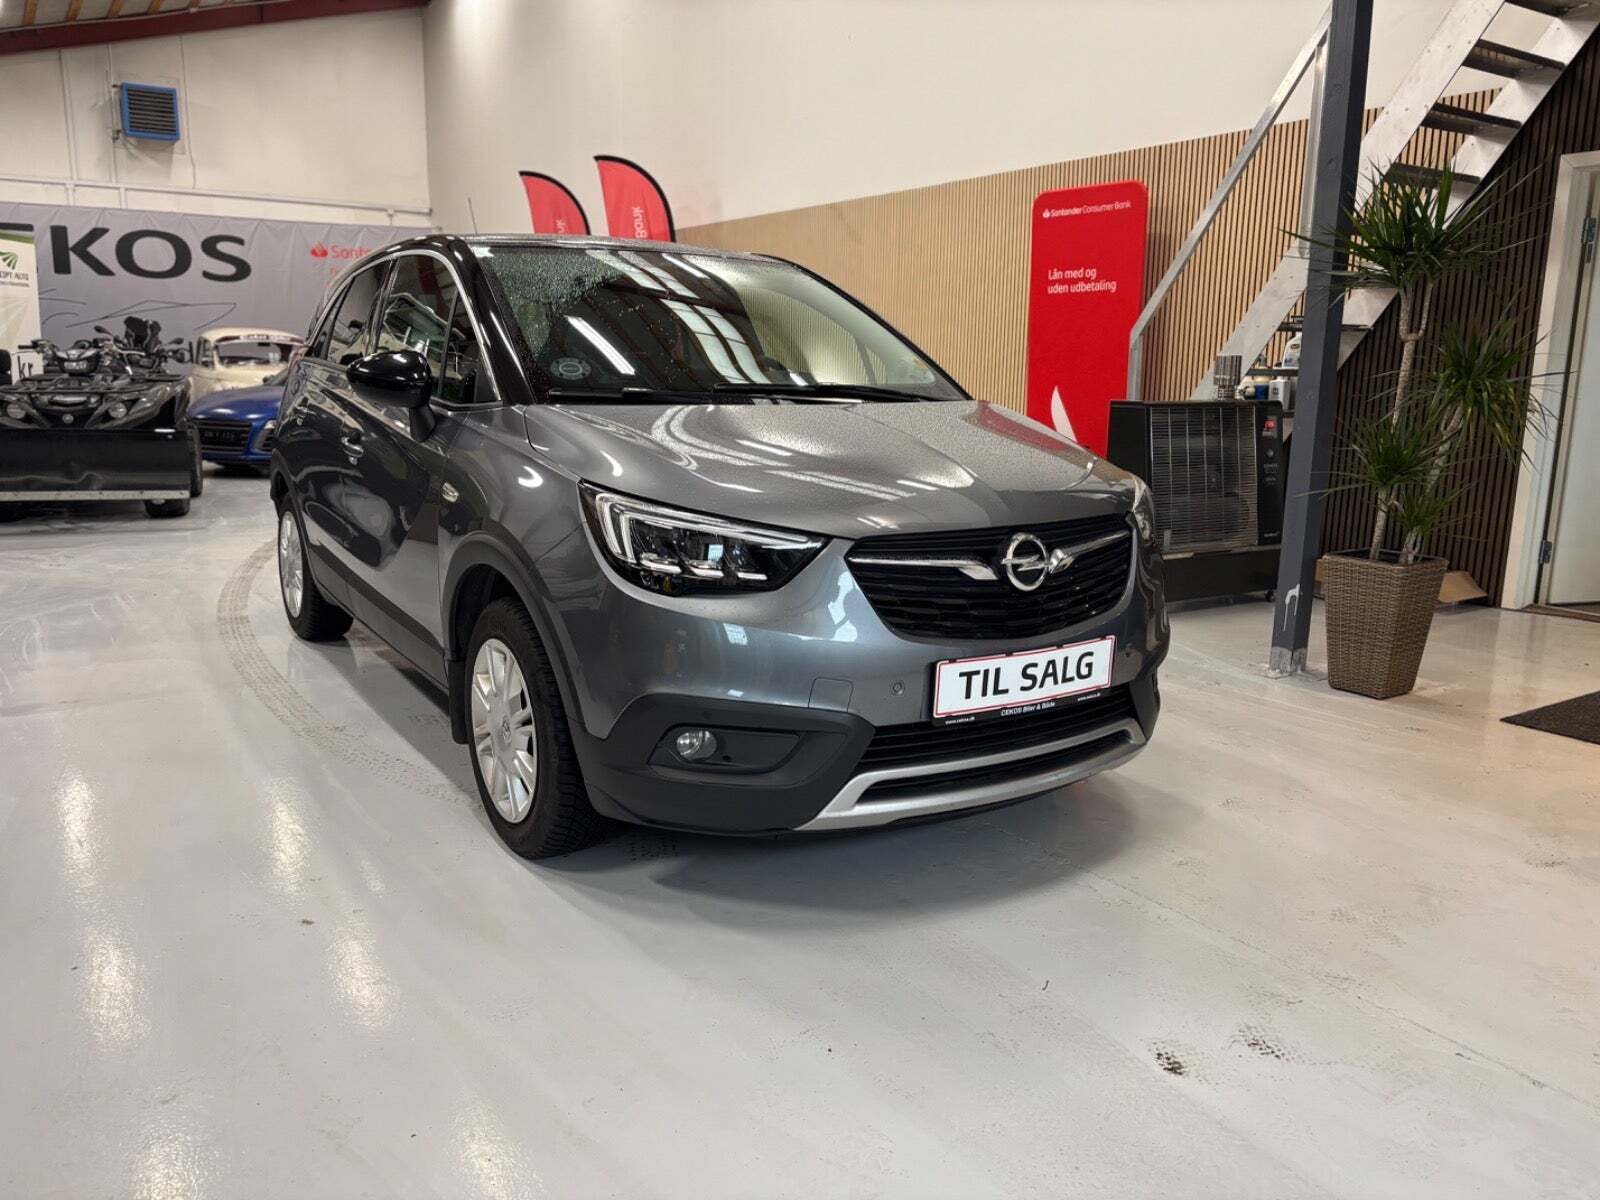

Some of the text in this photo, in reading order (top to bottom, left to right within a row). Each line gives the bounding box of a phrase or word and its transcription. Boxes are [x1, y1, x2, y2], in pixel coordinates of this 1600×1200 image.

[1114, 200, 1132, 210] Bank
[0, 222, 252, 283] KOS
[1047, 267, 1097, 280] Lån med og
[1047, 279, 1117, 294] uden udbetaling
[958, 651, 1095, 699] TIL SALG
